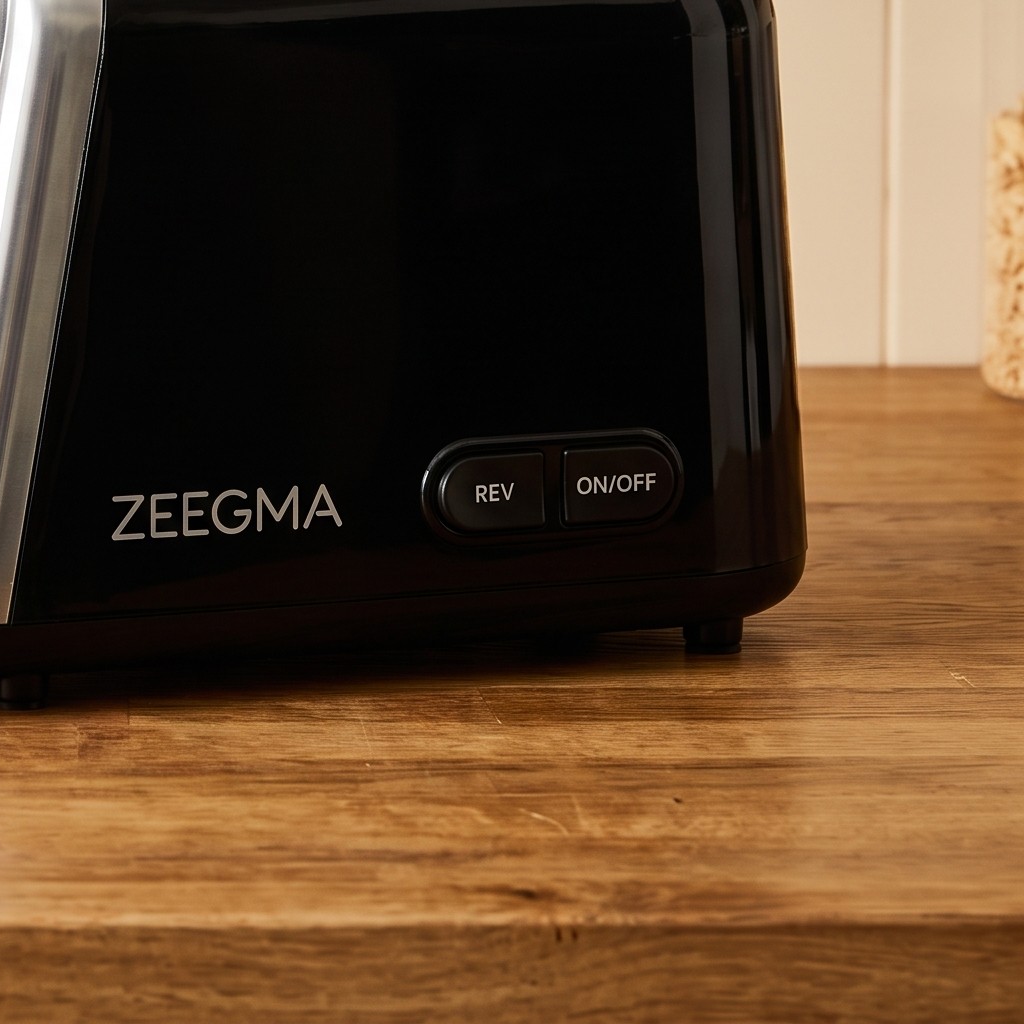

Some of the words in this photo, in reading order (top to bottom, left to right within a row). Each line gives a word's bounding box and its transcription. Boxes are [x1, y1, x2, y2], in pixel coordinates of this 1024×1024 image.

[475, 482, 515, 503] REV
[576, 472, 657, 495] ON/OFF
[111, 483, 343, 541] ZEEGMA
